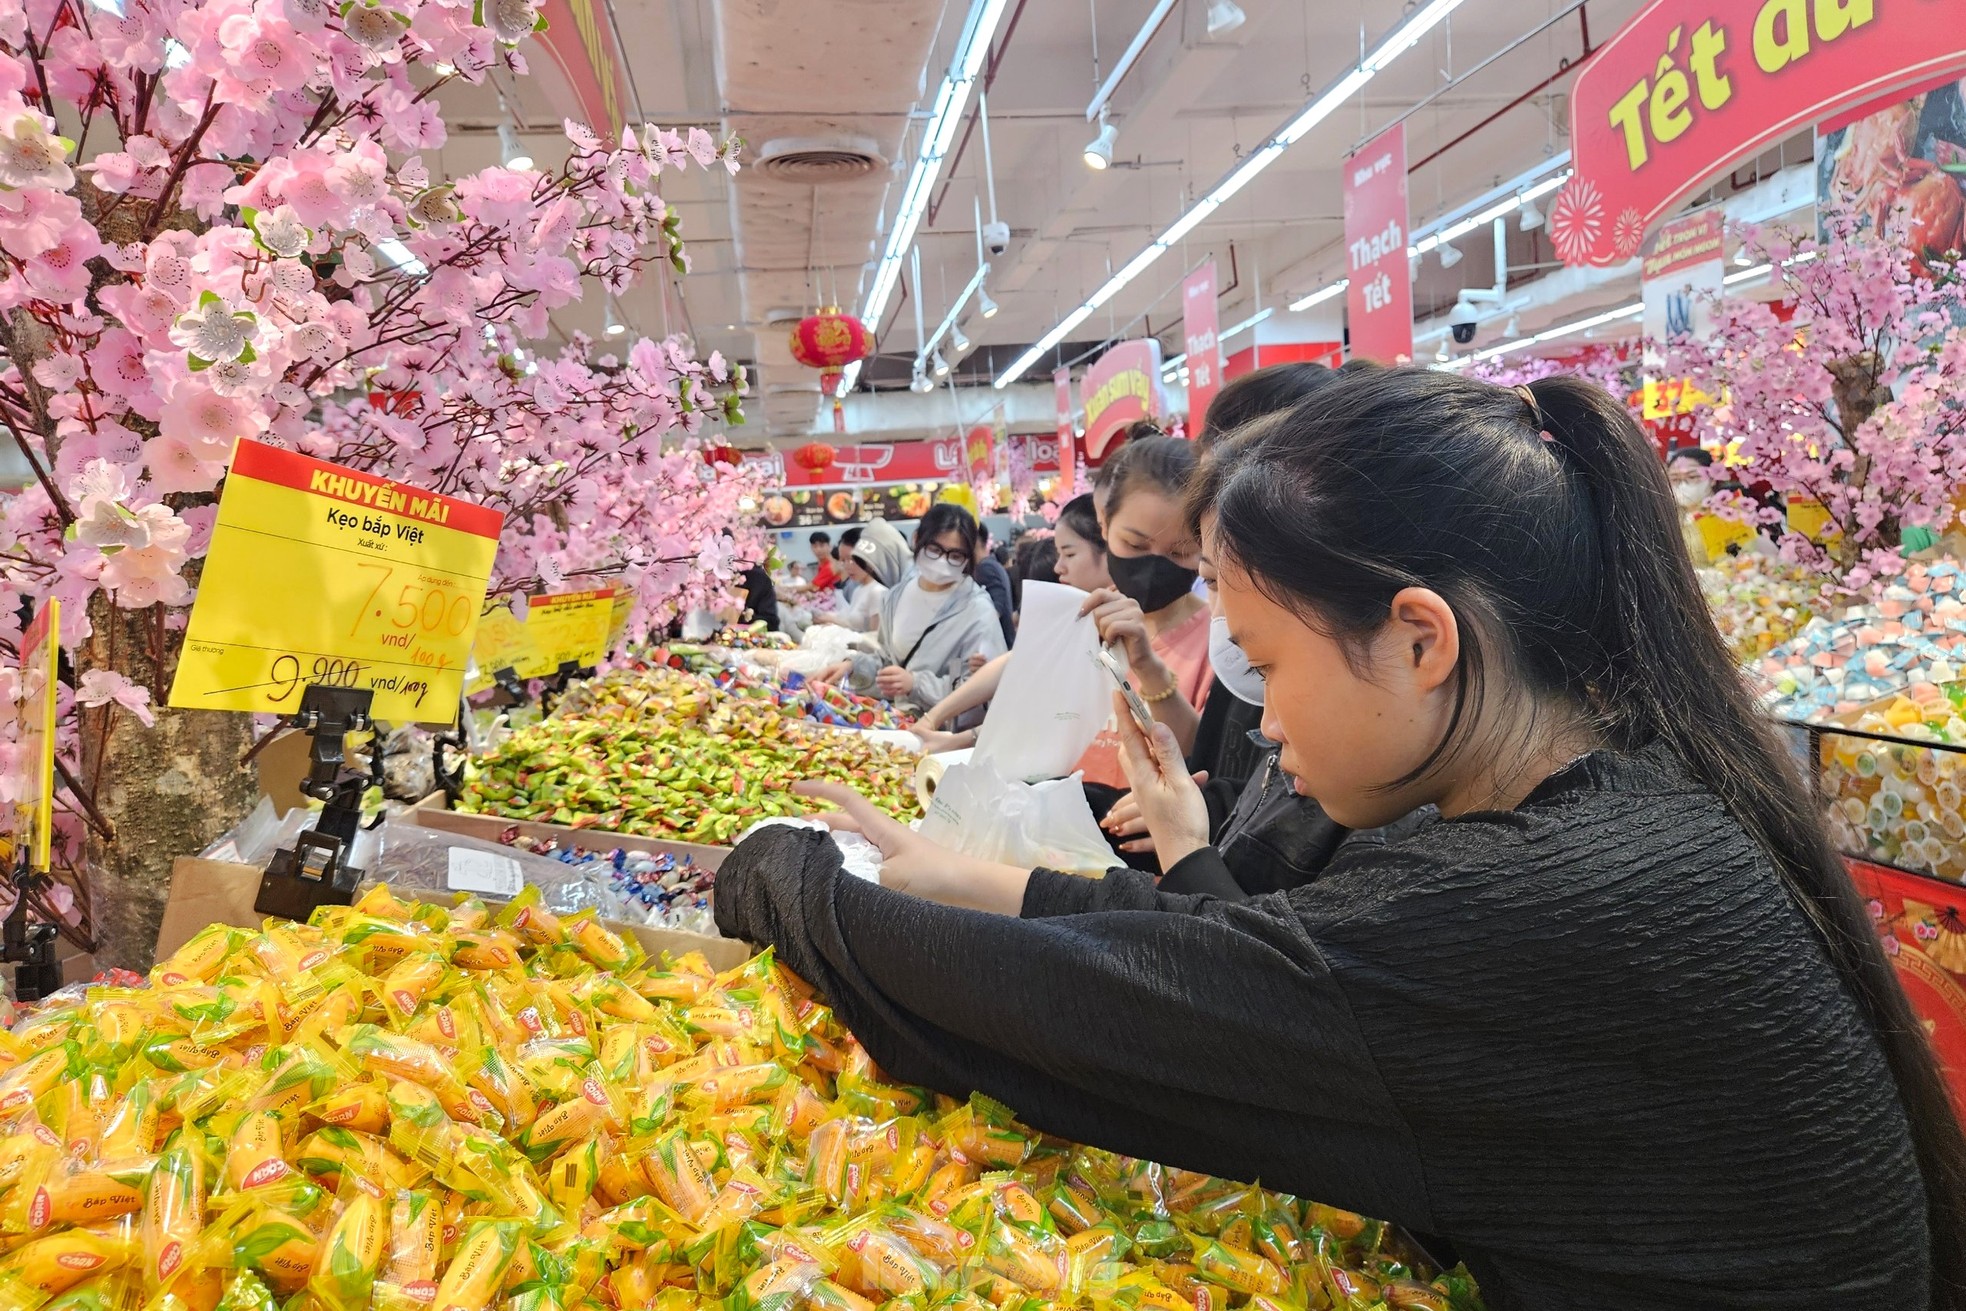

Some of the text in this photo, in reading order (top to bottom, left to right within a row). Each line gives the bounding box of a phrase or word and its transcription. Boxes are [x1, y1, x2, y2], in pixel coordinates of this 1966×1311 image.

[1608, 19, 1732, 172] Tết
[1350, 219, 1402, 271] Thạch
[1362, 272, 1392, 314] Tết
[310, 469, 450, 524] KHUYẾN MÃI
[327, 507, 424, 547] Kẹo bắp Việt
[351, 563, 471, 637] 7.500
[266, 654, 360, 702] 9.900
[438, 1009, 453, 1034] CORN
[584, 1082, 607, 1104] CORN
[326, 1110, 353, 1124] CORN
[253, 1160, 285, 1182] CORN
[852, 1166, 860, 1190] CORN
[33, 1194, 45, 1225] CORN
[443, 1227, 455, 1239] CO
[59, 1256, 97, 1268] CORN
[162, 1245, 181, 1273] CORN
[786, 1245, 818, 1263] CORN
[406, 1285, 436, 1297] CORN
